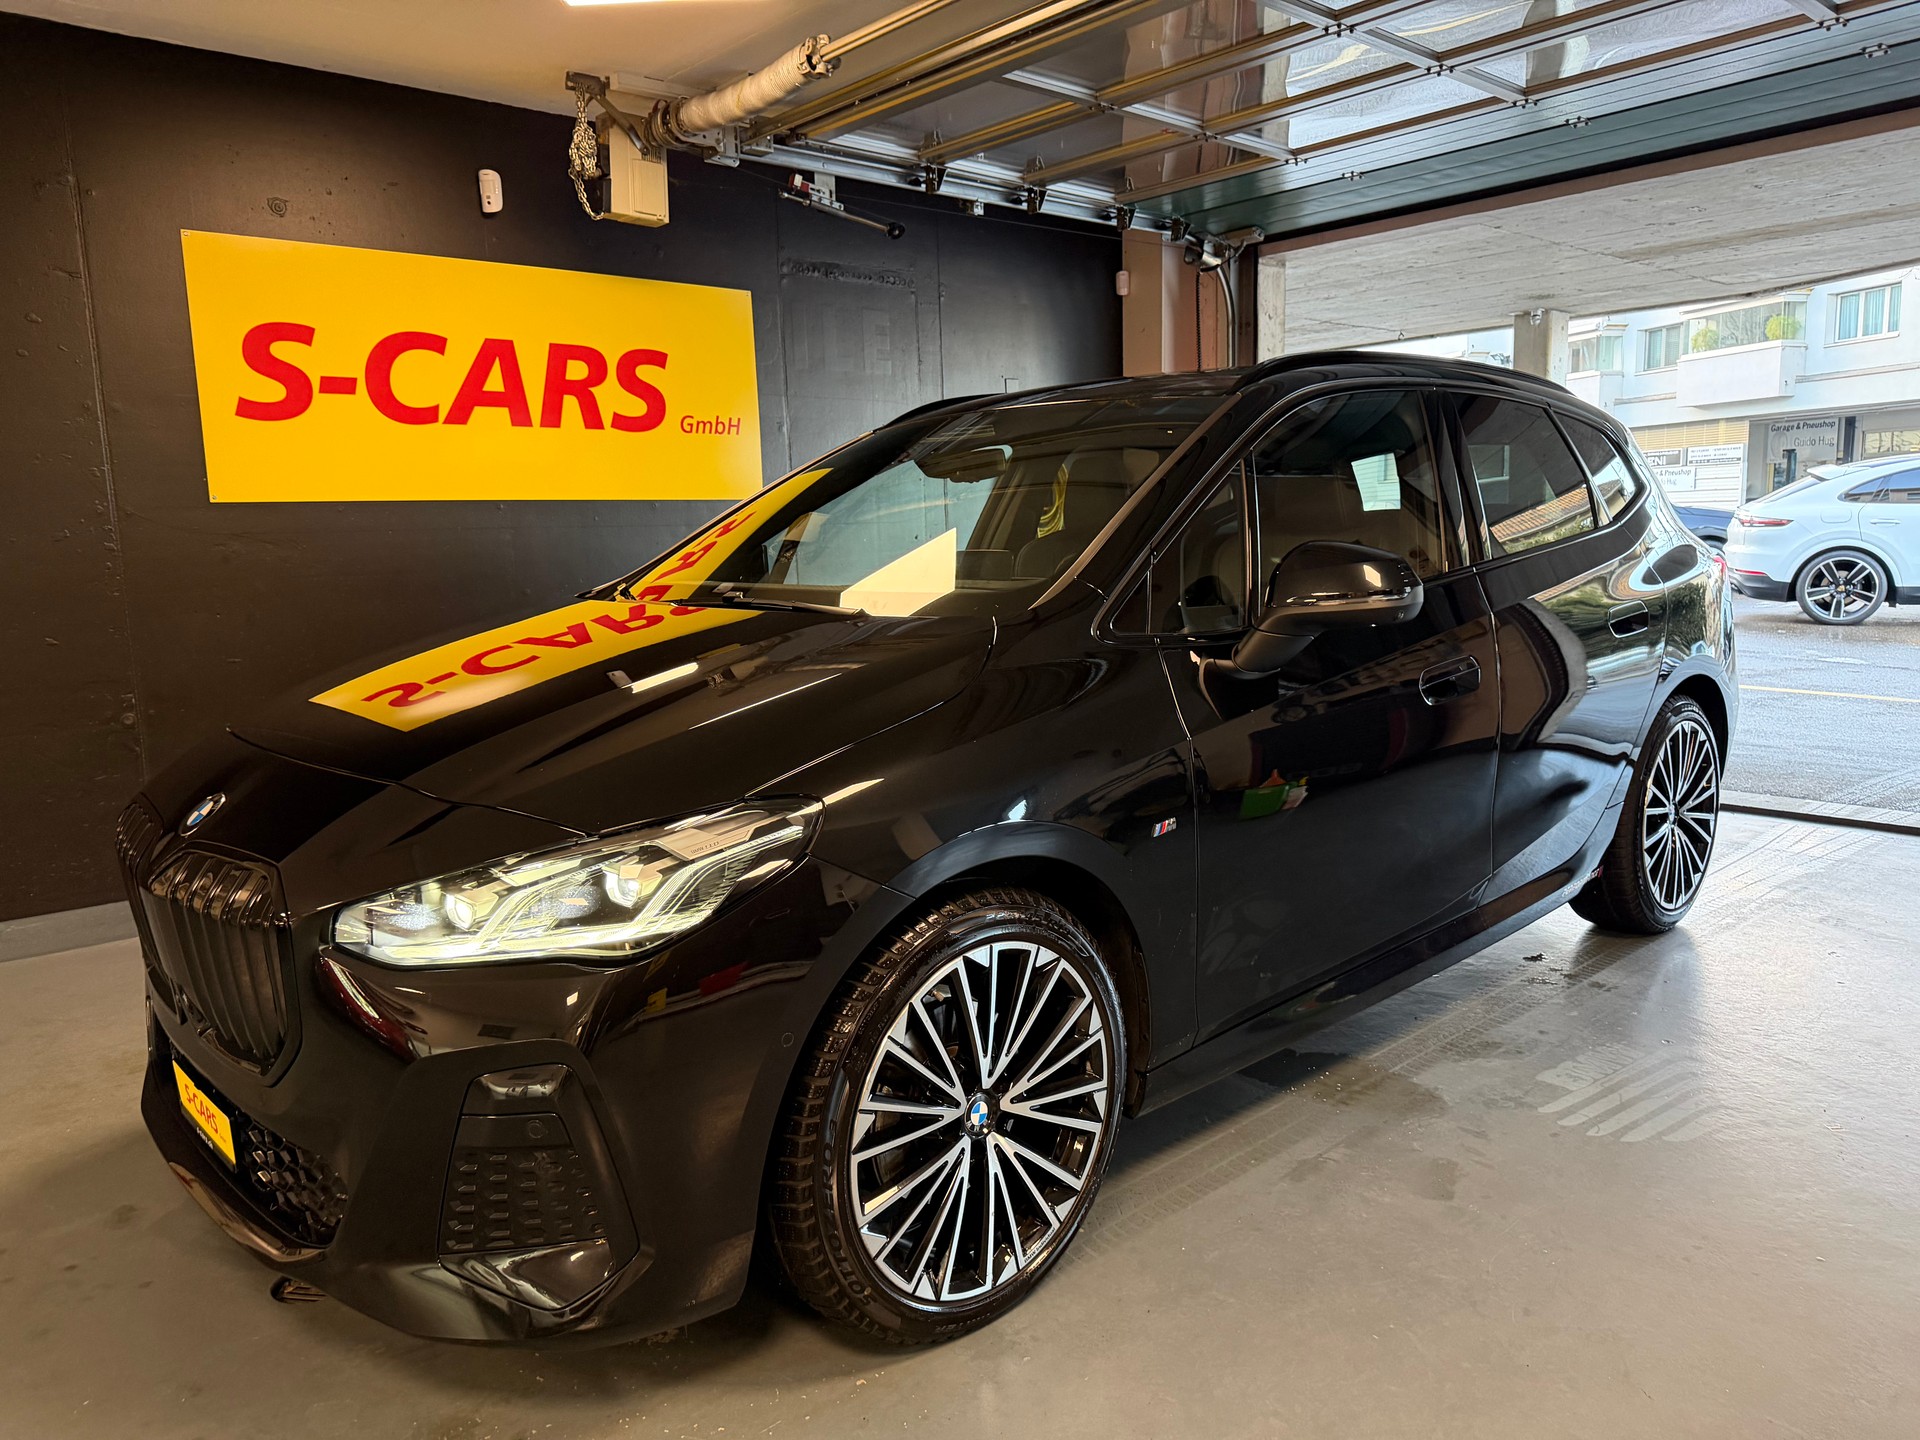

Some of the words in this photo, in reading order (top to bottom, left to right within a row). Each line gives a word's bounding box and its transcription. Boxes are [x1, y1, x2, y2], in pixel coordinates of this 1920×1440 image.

[234, 321, 669, 433] S-CARS
[679, 413, 742, 436] GmbH
[1770, 423, 1795, 432] Garage
[1795, 422, 1801, 430] &
[1802, 420, 1836, 430] Pneushop
[1793, 436, 1816, 447] Guido
[1818, 435, 1835, 447] Hug
[184, 1083, 219, 1134] S-CARS
